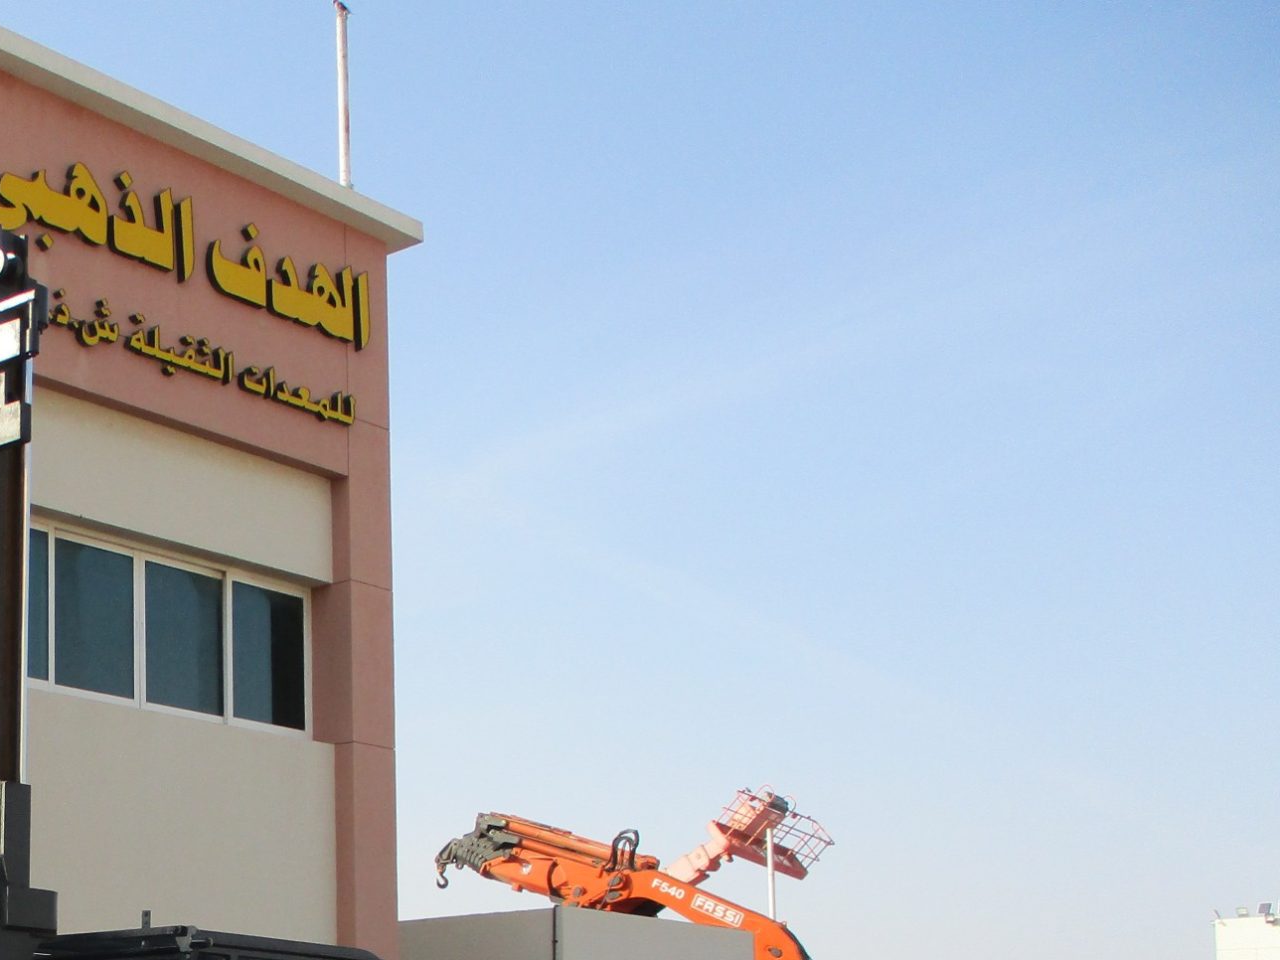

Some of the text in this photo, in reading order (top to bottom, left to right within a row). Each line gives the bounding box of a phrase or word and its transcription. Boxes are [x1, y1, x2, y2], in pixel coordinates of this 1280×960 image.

[207, 223, 370, 350] الهدف
[125, 312, 234, 385] الثقيلة
[239, 366, 356, 426] للمعدات
[651, 878, 686, 900] F540
[694, 896, 741, 924] FASSI
